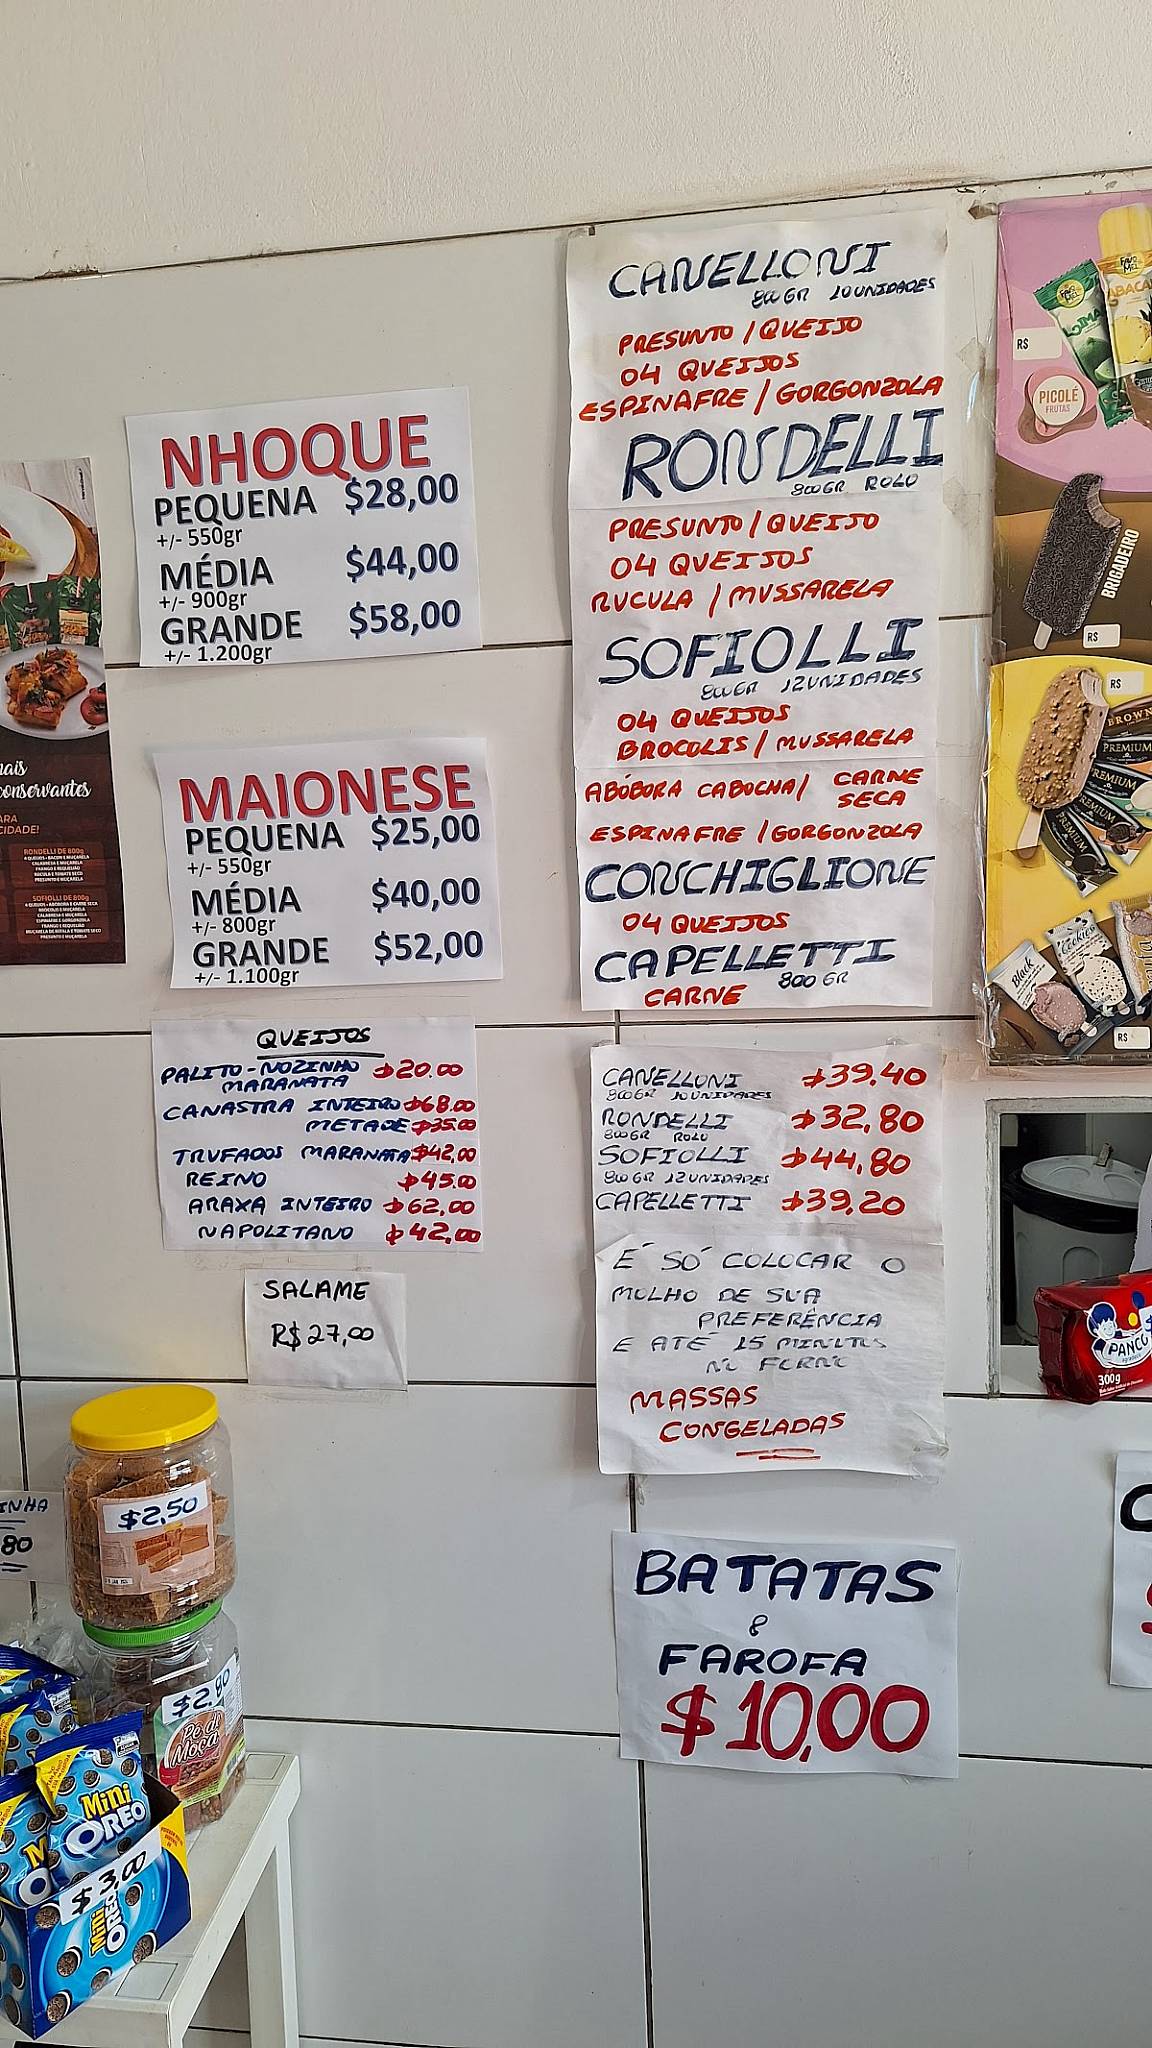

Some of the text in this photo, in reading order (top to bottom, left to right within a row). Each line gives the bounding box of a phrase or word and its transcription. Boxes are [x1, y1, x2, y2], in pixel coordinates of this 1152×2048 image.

[608, 241, 891, 298] CANELLONI
[619, 325, 734, 356] PRESUNTO
[620, 352, 800, 387] 04 QUEIJOS
[578, 387, 750, 422] ESPINAFRE
[1039, 385, 1079, 404] PICOLÉ
[1045, 404, 1071, 414] FRUTAS
[161, 414, 431, 490] NHOQUE
[622, 408, 944, 502] RONDELLI
[864, 473, 919, 491] ROLO
[154, 473, 459, 526] PEQUENA $28,00
[156, 527, 243, 550] +/- 550gr
[160, 541, 459, 591] MÉDIA $44,00
[610, 546, 813, 580] 04 QUEIJOS
[1101, 528, 1141, 599] BRIGADEIRO
[158, 590, 248, 613] +/- 900gr
[591, 578, 895, 614] RUCULA MUSSARELA
[160, 600, 461, 645] GRANDE $58,00
[163, 644, 273, 665] +/- 1.200gr
[598, 617, 924, 686] SOFIOLLI
[617, 703, 791, 733] 04 QUEIJOS
[617, 727, 914, 761] BROCOLIS MUSSARELA
[1103, 743, 1152, 753] PREMIUM
[833, 767, 924, 787] CARNE
[179, 764, 476, 823] MAIONESE
[837, 790, 906, 809] SECA
[186, 814, 481, 856] PEQUENA $25,00
[589, 824, 746, 844] ESPINAFRE
[1056, 811, 1088, 853] PREMIUM
[187, 857, 272, 877] +/- 550gr
[584, 855, 936, 903] CONCHIGLIONE
[191, 877, 481, 917] MÉDIA $40,00
[191, 916, 276, 936] +/- 800gr
[622, 911, 791, 935] 04 QUEIJOS
[192, 930, 483, 968] GRANDE $52,00
[594, 938, 897, 984] CAPELLETTI
[194, 967, 299, 986] +/- 1.100gr
[1011, 956, 1034, 988] Black
[644, 983, 748, 1009] CARNE
[256, 1027, 371, 1050] QUEIJOS
[222, 1075, 349, 1094] MARANATA
[602, 1066, 743, 1089] CANELLONI
[162, 1098, 295, 1122] CANASTRA
[308, 1098, 401, 1112] INTEIRO
[602, 1107, 734, 1131] RONDELLI
[306, 1118, 411, 1134] METADE
[173, 1146, 284, 1165] TRUFADOS
[301, 1146, 411, 1164] MARANATA
[598, 1144, 749, 1166] SOFIOLLI
[186, 1171, 267, 1188] REINO
[188, 1196, 266, 1215] ARAXA
[280, 1197, 372, 1212] INTEIRO
[595, 1190, 752, 1213] CAPELLETTI
[198, 1224, 353, 1241] NAPOLITANO
[661, 1245, 713, 1273] SÓ
[722, 1251, 853, 1271] COLOCAR
[881, 1256, 906, 1274] O
[263, 1279, 369, 1302] SALAME
[719, 1287, 751, 1303] DE
[767, 1287, 821, 1305] SUA
[698, 1307, 882, 1330] PREFERÊNCIA
[612, 1336, 635, 1352] E
[650, 1331, 719, 1352] ATÉ
[734, 1336, 766, 1352] 15
[1098, 1373, 1121, 1386] 300g
[629, 1385, 759, 1415] MASSAS
[659, 1412, 846, 1443] CONGELADAS
[634, 1549, 942, 1604] BATATAS
[658, 1644, 868, 1676] FAROFA
[182, 1721, 203, 1741] Pé
[66, 1802, 146, 1854] OREO
